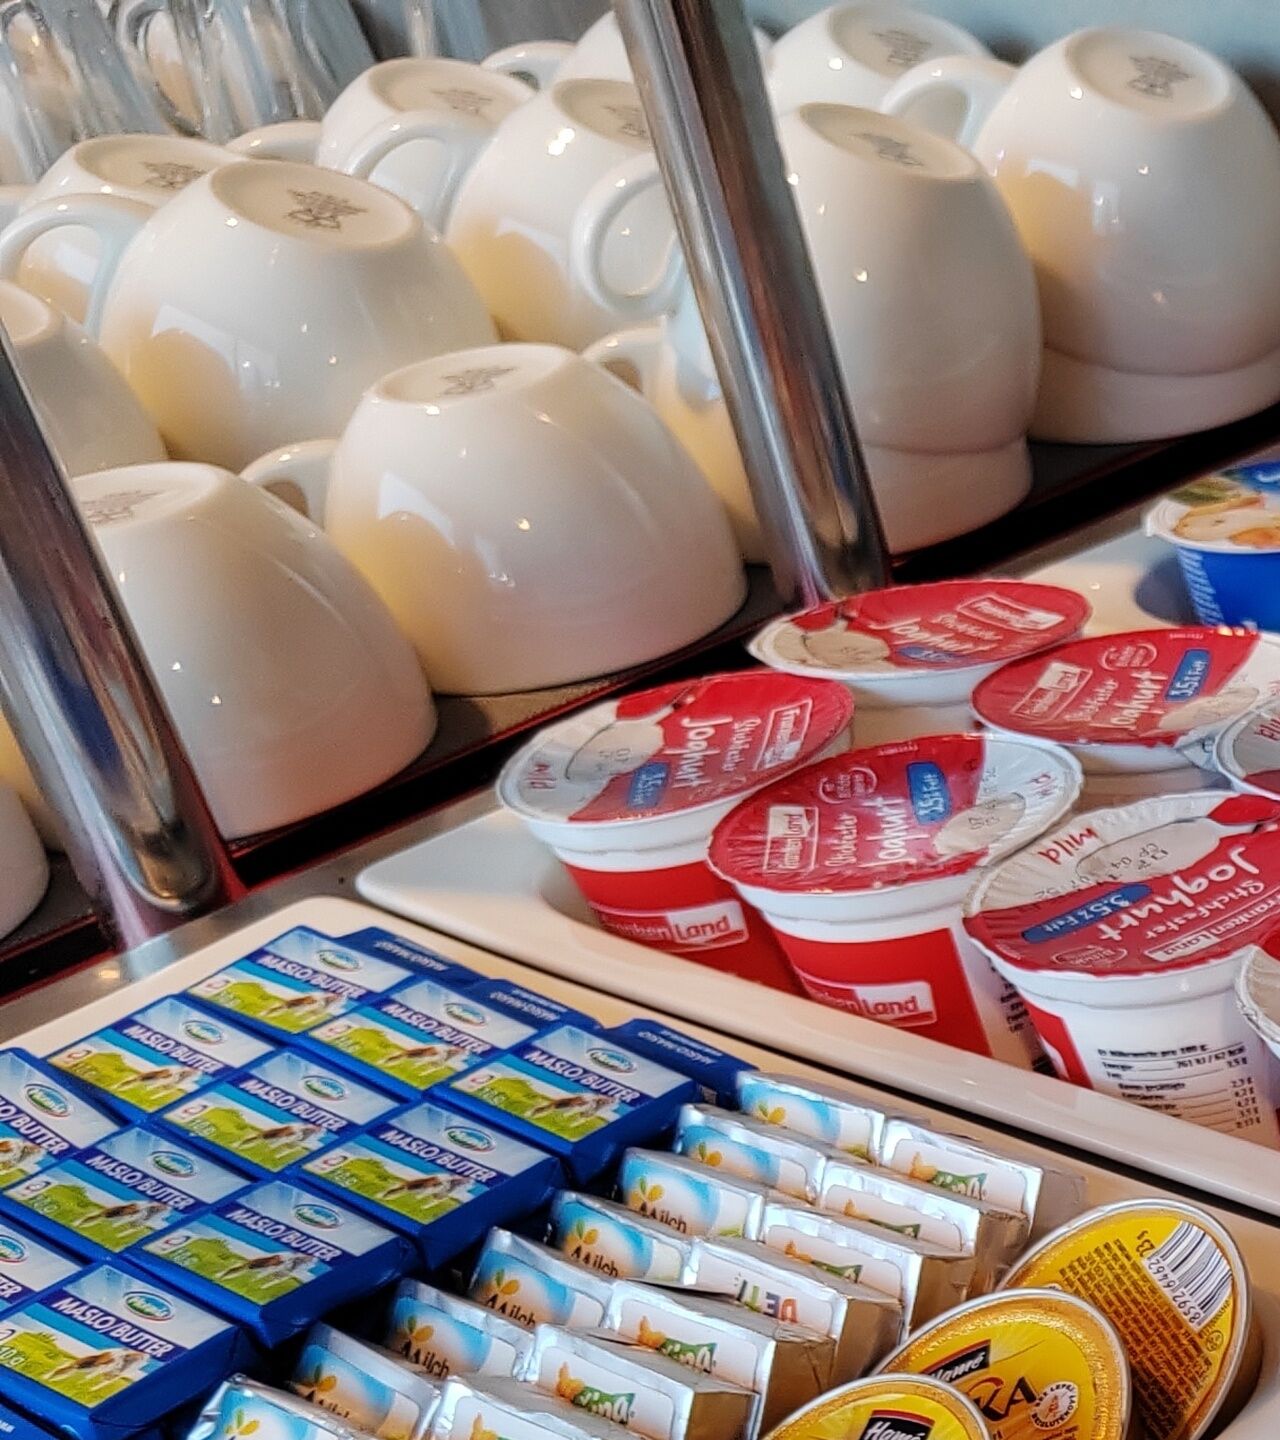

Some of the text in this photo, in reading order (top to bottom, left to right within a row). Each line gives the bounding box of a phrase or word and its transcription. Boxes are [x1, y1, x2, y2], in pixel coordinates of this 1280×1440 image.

[663, 715, 734, 789] Joghurt
[858, 797, 930, 868] Joghurt
[1037, 826, 1098, 865] Mild
[1100, 845, 1261, 942] Joghurt
[1144, 879, 1266, 940] Stichfester
[524, 1049, 641, 1103] MASLO/BUTTER
[380, 1129, 498, 1184] MASLO/BUTTER
[226, 1208, 343, 1262] MASLO/BUTTER
[52, 1297, 175, 1358] MASLO/BUTTER
